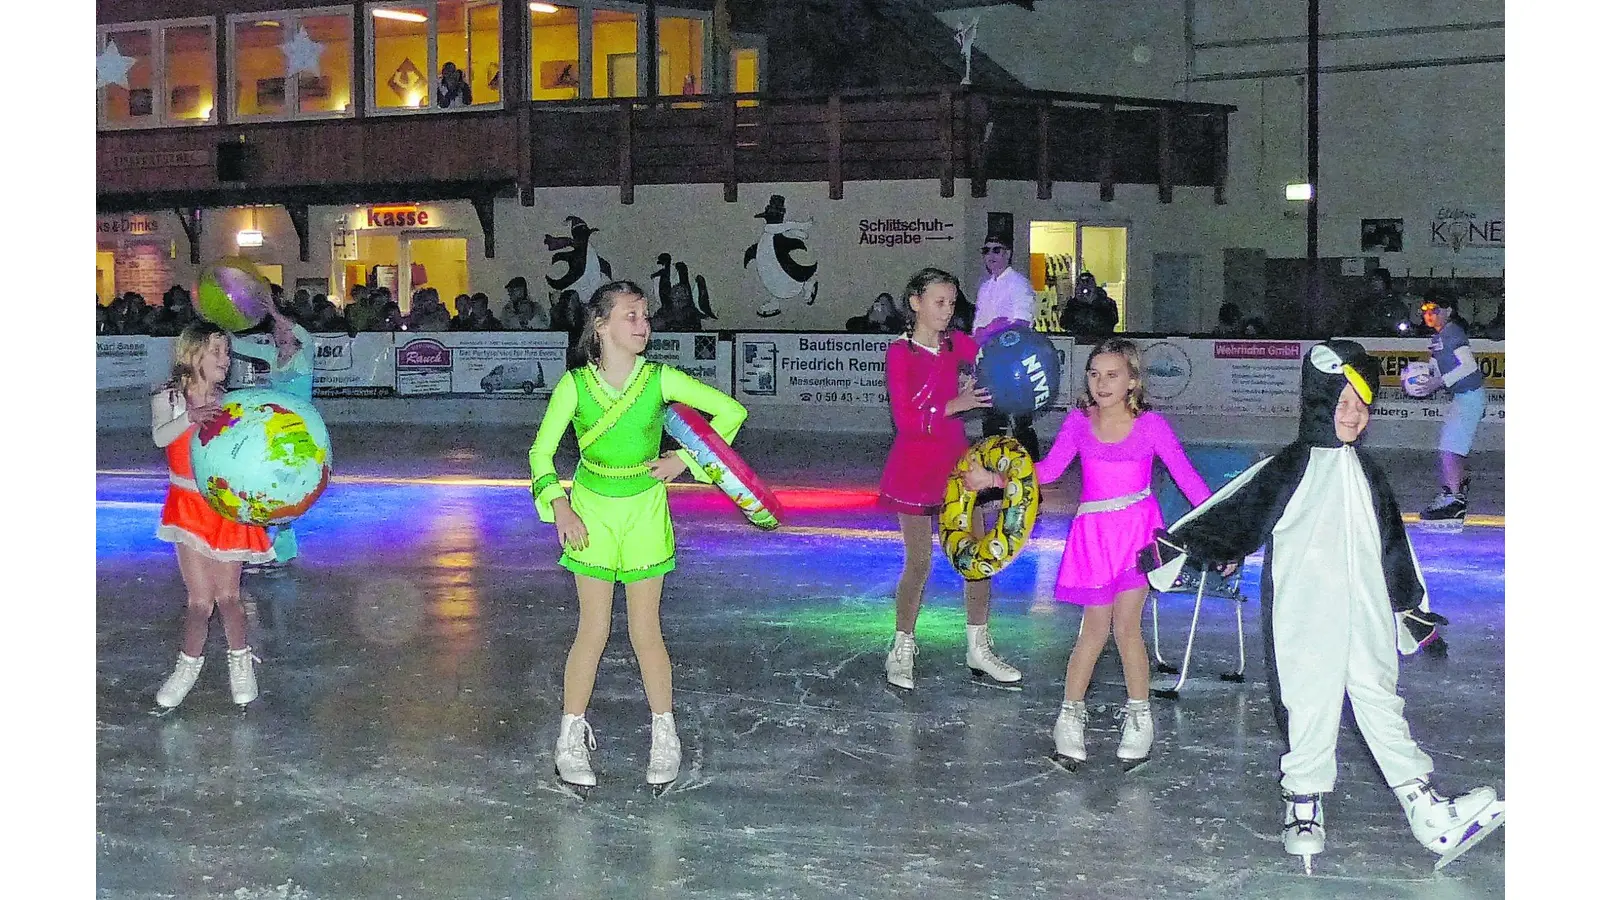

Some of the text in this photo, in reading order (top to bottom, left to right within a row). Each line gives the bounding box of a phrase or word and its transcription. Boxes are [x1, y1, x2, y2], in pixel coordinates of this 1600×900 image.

[859, 231, 922, 247] Ausgabe
[1268, 345, 1299, 356] GmbH
[406, 351, 442, 364] Rauch
[781, 357, 844, 371] Friedrich
[825, 392, 837, 402] 50
[841, 392, 853, 402] 43
